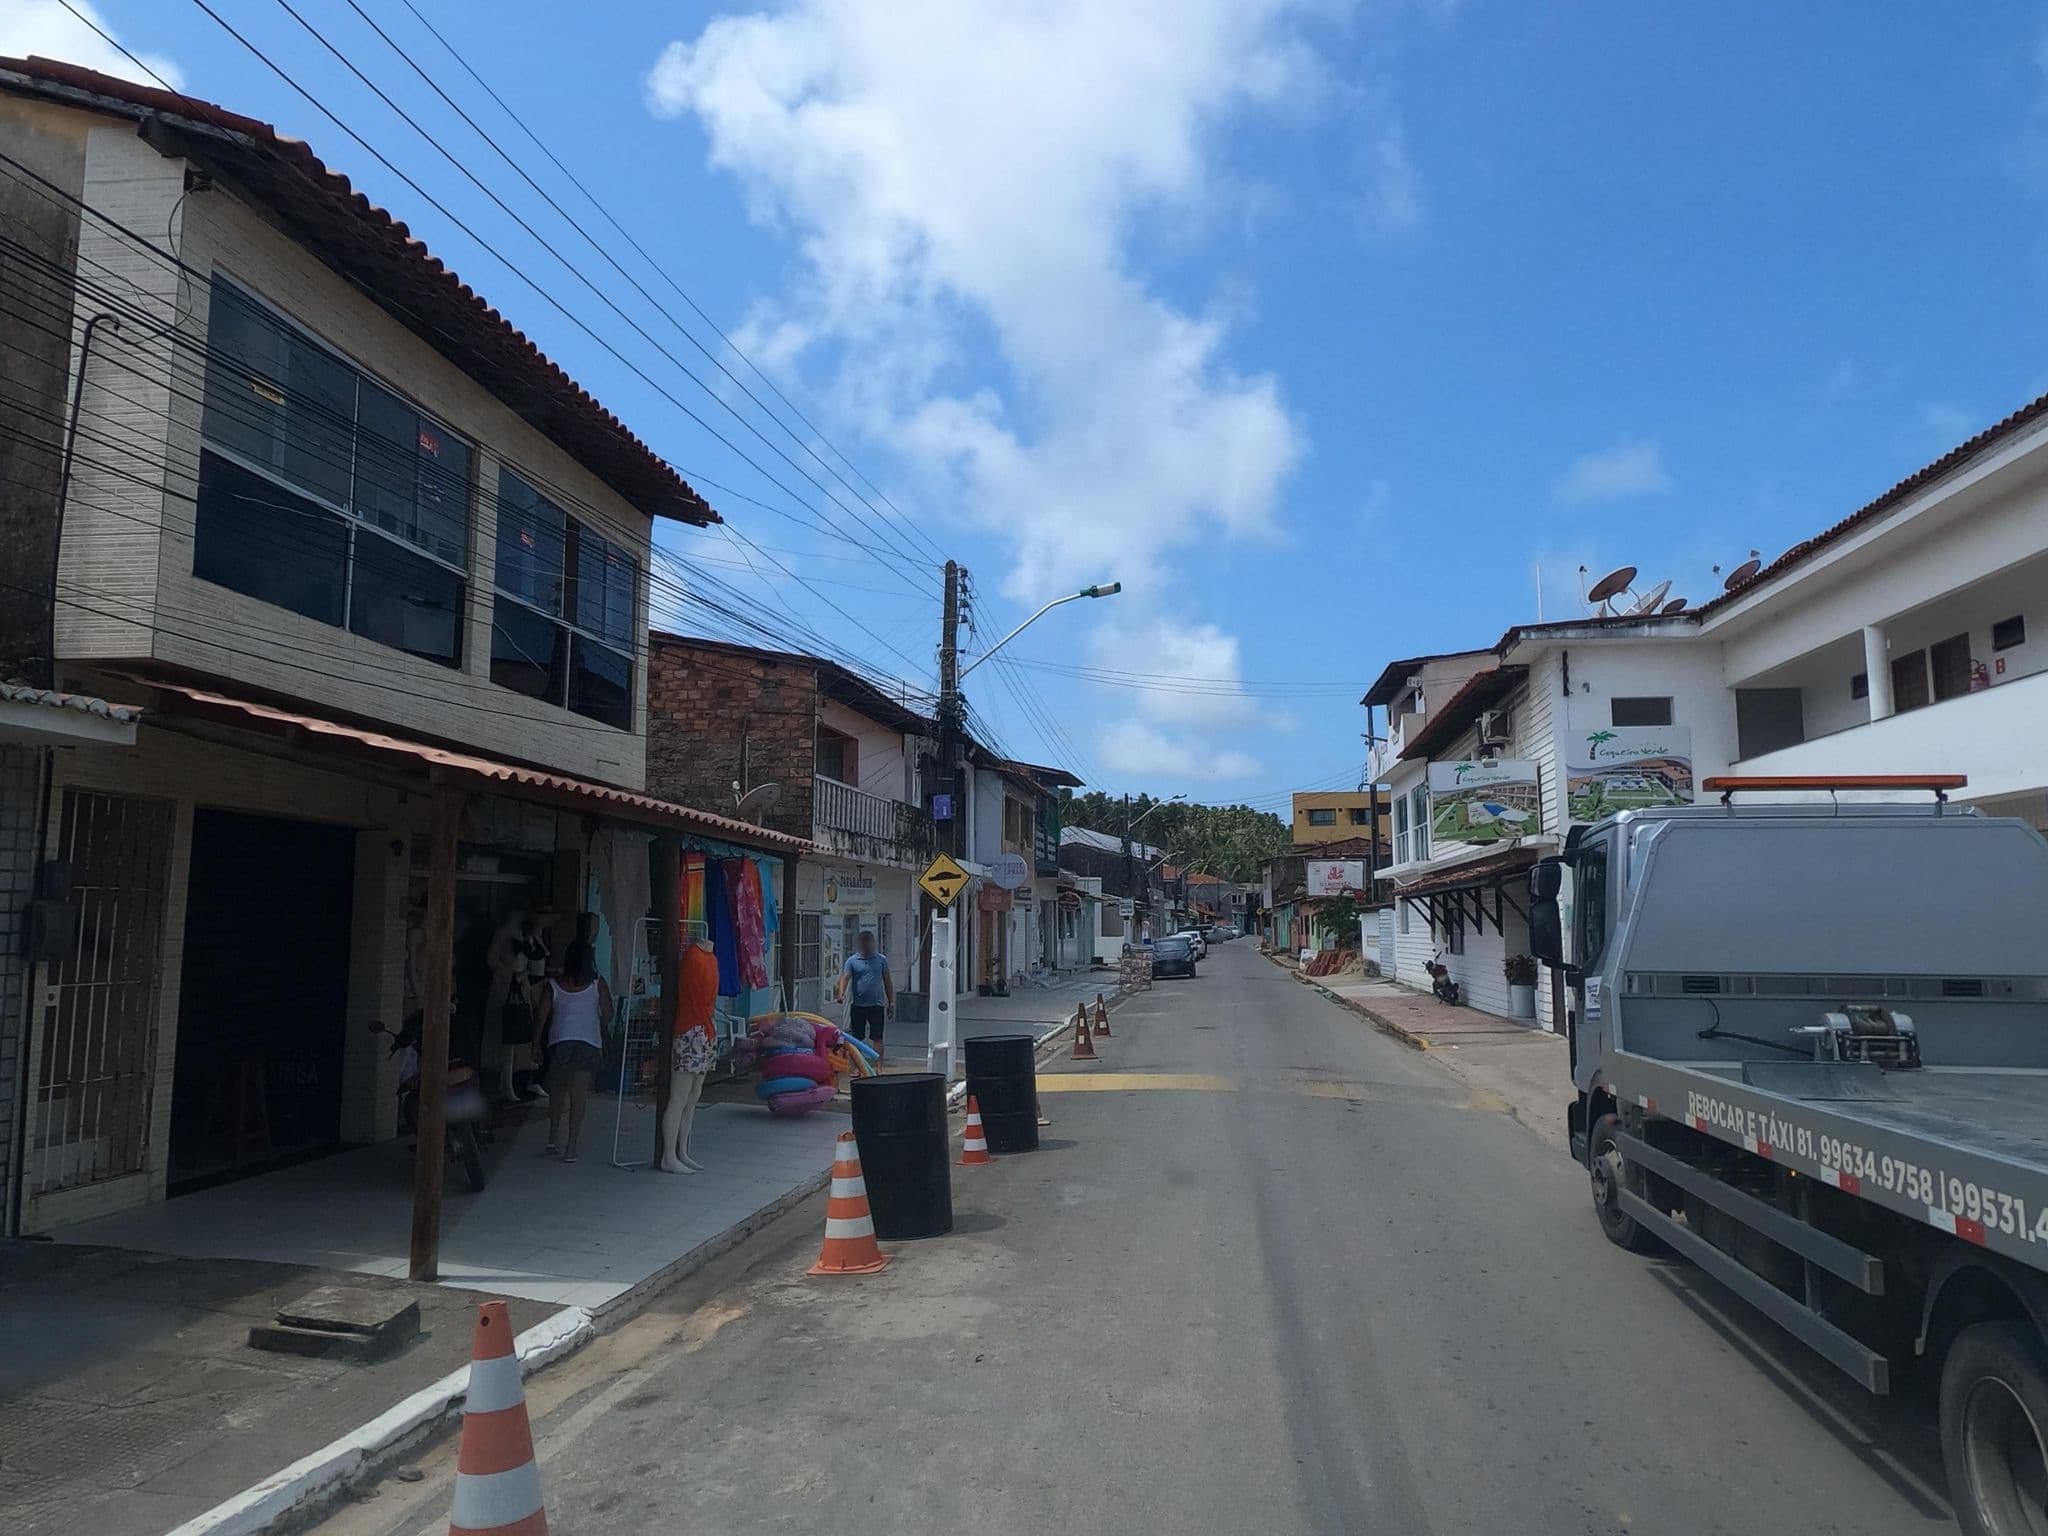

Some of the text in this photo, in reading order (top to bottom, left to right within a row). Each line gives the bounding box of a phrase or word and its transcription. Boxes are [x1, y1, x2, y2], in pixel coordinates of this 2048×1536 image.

[1599, 748, 1640, 758] Coqueiro
[1687, 1090, 1745, 1134] REBOCAR
[1747, 1111, 1757, 1138] E
[1759, 1109, 1794, 1153] TÁXI
[1821, 1134, 1934, 1206] 99634.9758
